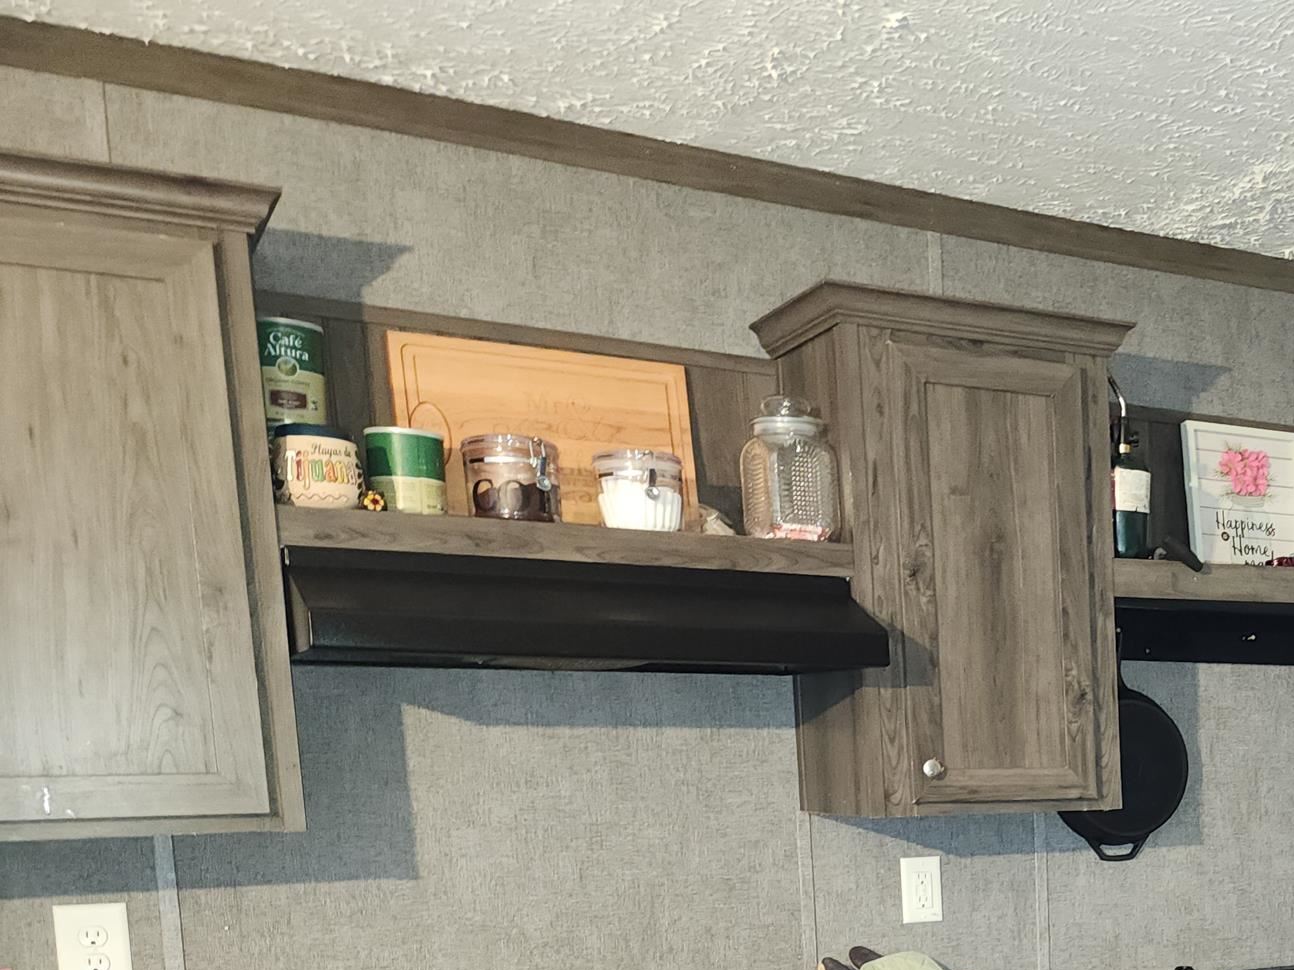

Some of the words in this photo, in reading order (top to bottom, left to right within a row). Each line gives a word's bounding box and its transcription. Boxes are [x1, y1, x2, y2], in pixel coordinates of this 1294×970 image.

[269, 331, 303, 348] Café
[264, 343, 309, 361] Altura
[284, 450, 358, 489] Tijuana
[1216, 510, 1275, 538] Happiness
